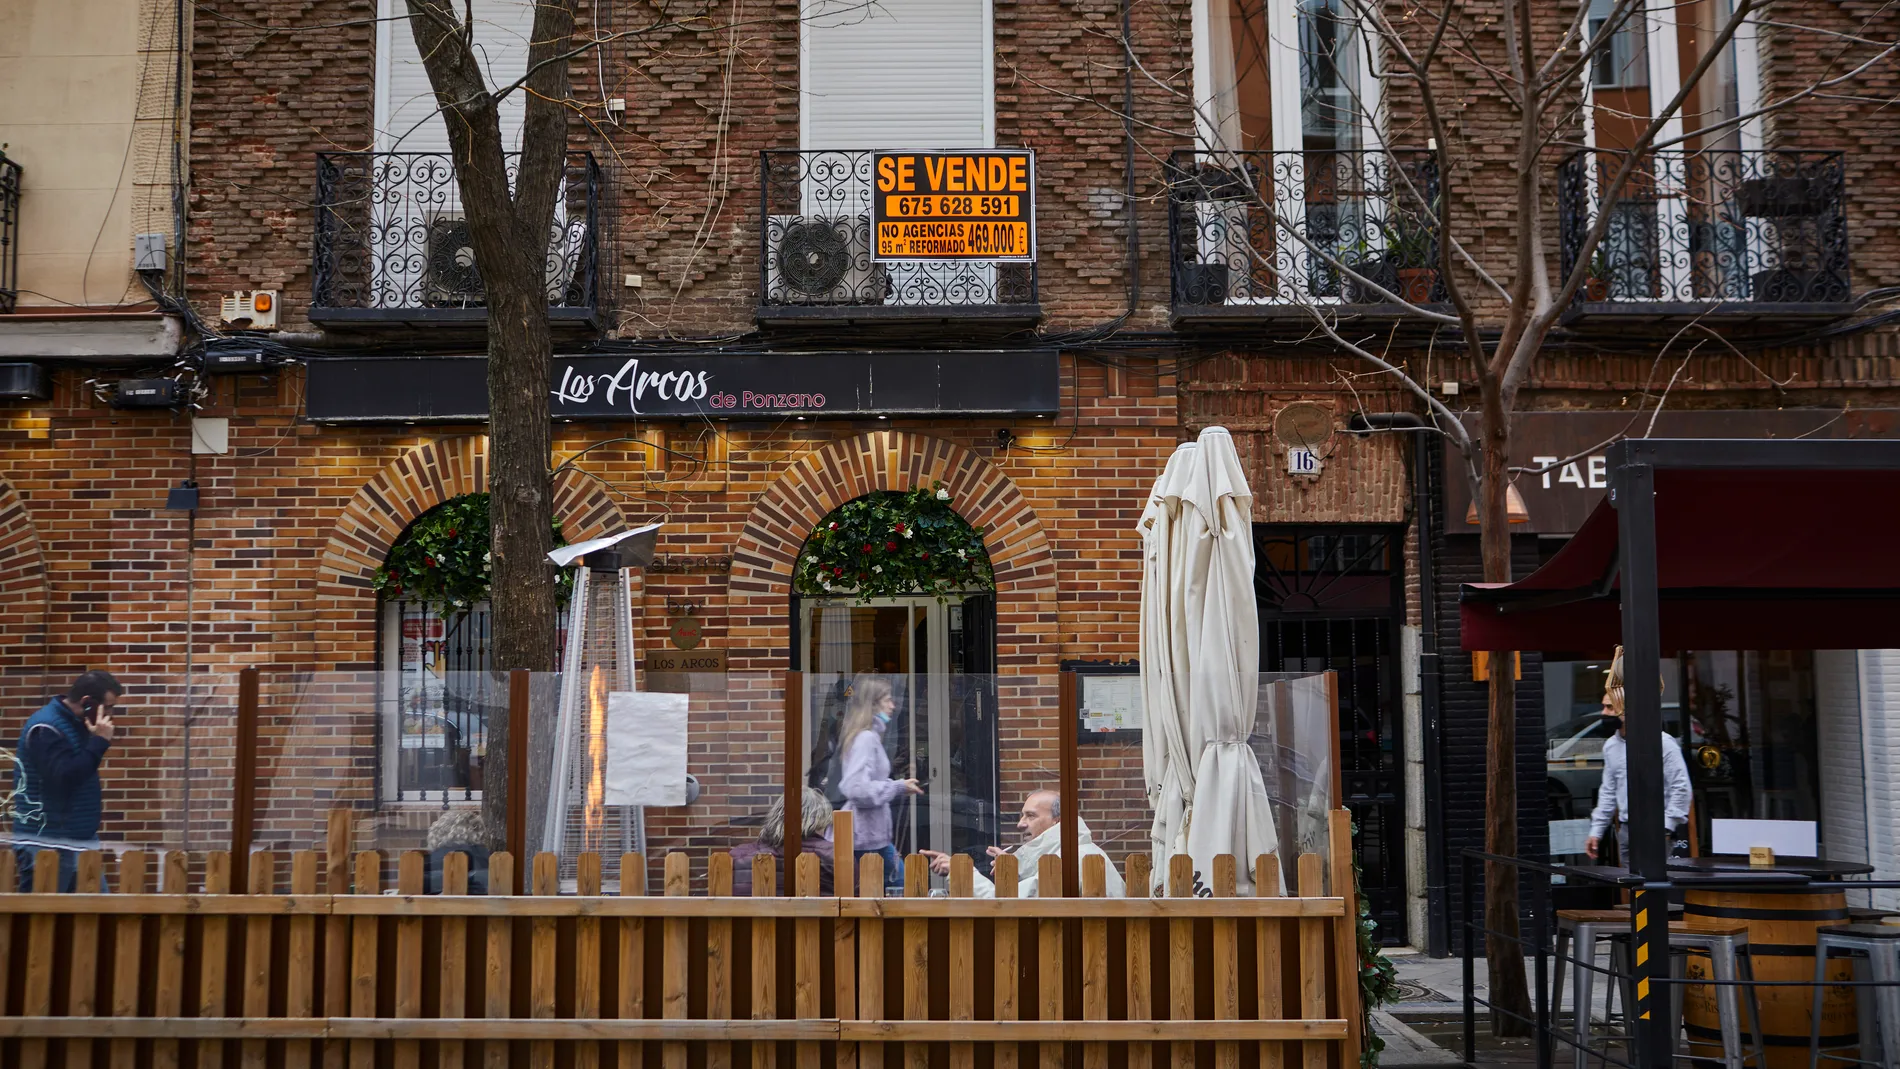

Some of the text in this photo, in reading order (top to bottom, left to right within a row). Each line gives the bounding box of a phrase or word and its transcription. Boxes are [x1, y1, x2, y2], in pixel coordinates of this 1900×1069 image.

[877, 156, 1027, 192] SE VENDE
[899, 196, 1011, 215] 675 628 591
[881, 223, 965, 238] NO AGENCIAS
[967, 223, 1014, 253] 469.000
[881, 241, 892, 253] 95
[909, 239, 966, 253] REFORMADO
[551, 358, 826, 414] Los Arcos de Ponzano
[1293, 451, 1314, 471] 16
[667, 592, 706, 615] bar
[653, 658, 720, 670] LOS ARCOS
